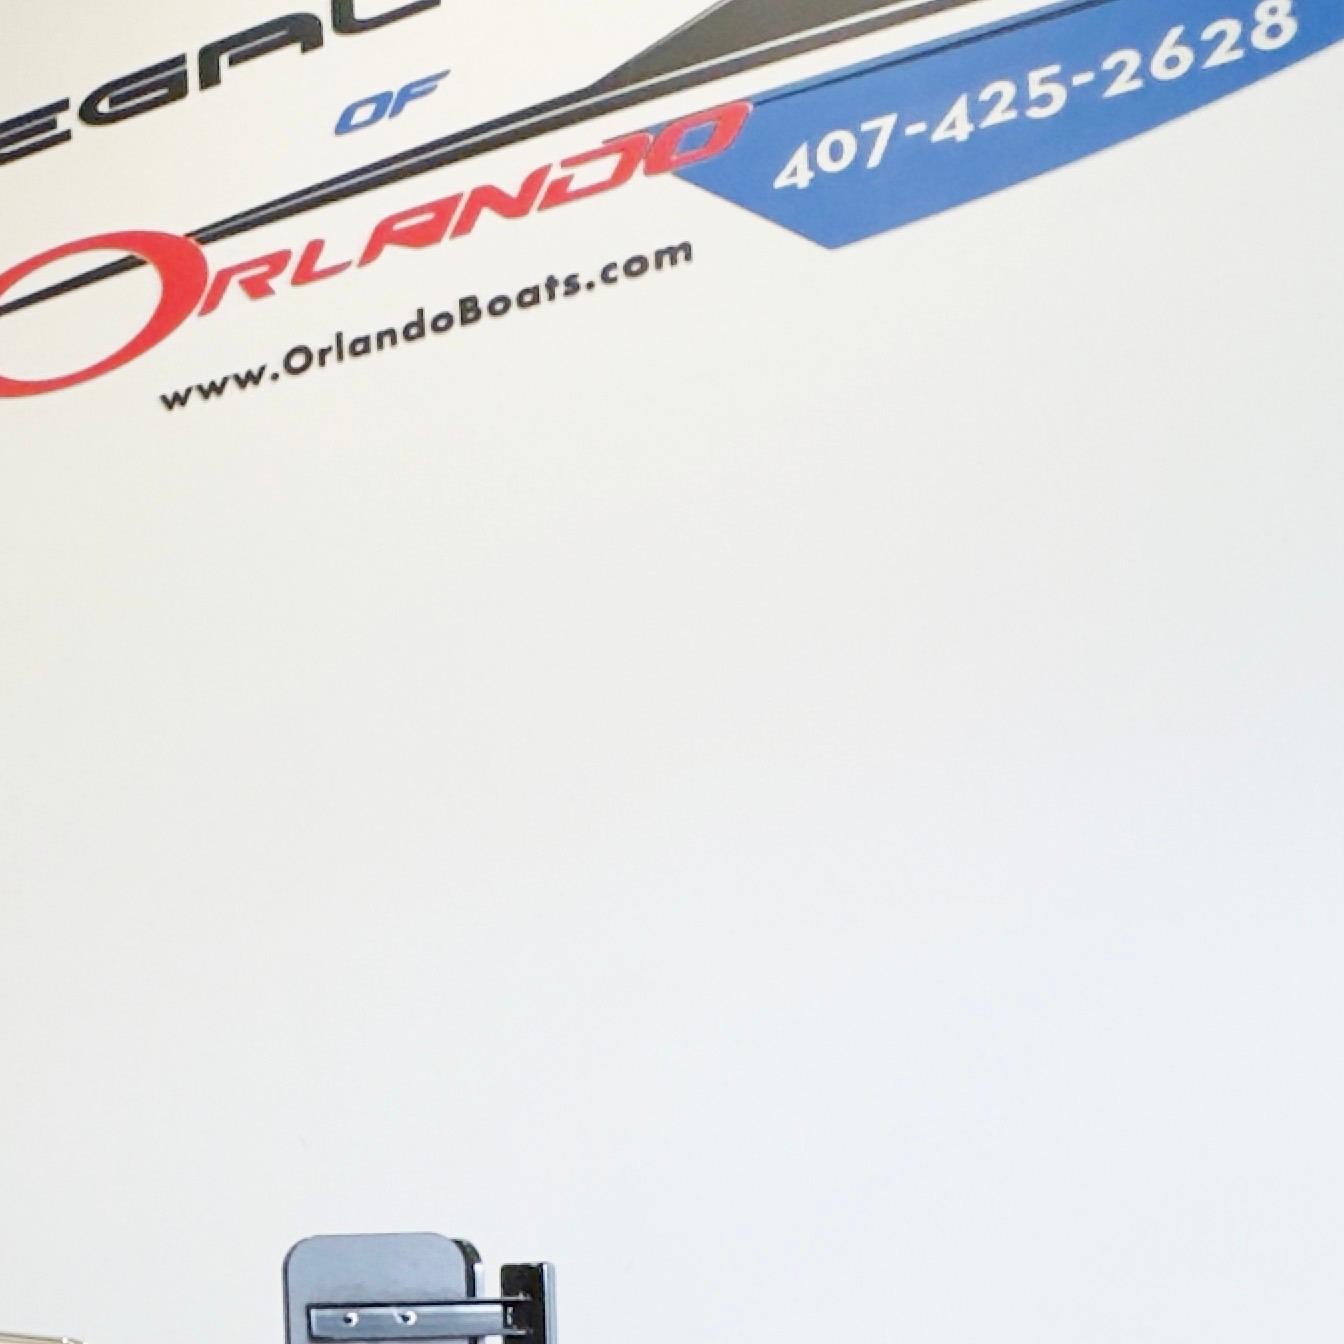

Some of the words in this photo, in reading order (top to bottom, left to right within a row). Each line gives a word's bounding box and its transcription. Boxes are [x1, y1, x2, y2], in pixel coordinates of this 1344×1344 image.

[333, 69, 452, 137] OF
[772, 0, 1299, 191] 407-425-2628
[158, 237, 694, 412] www.OrlandoBoats.com
